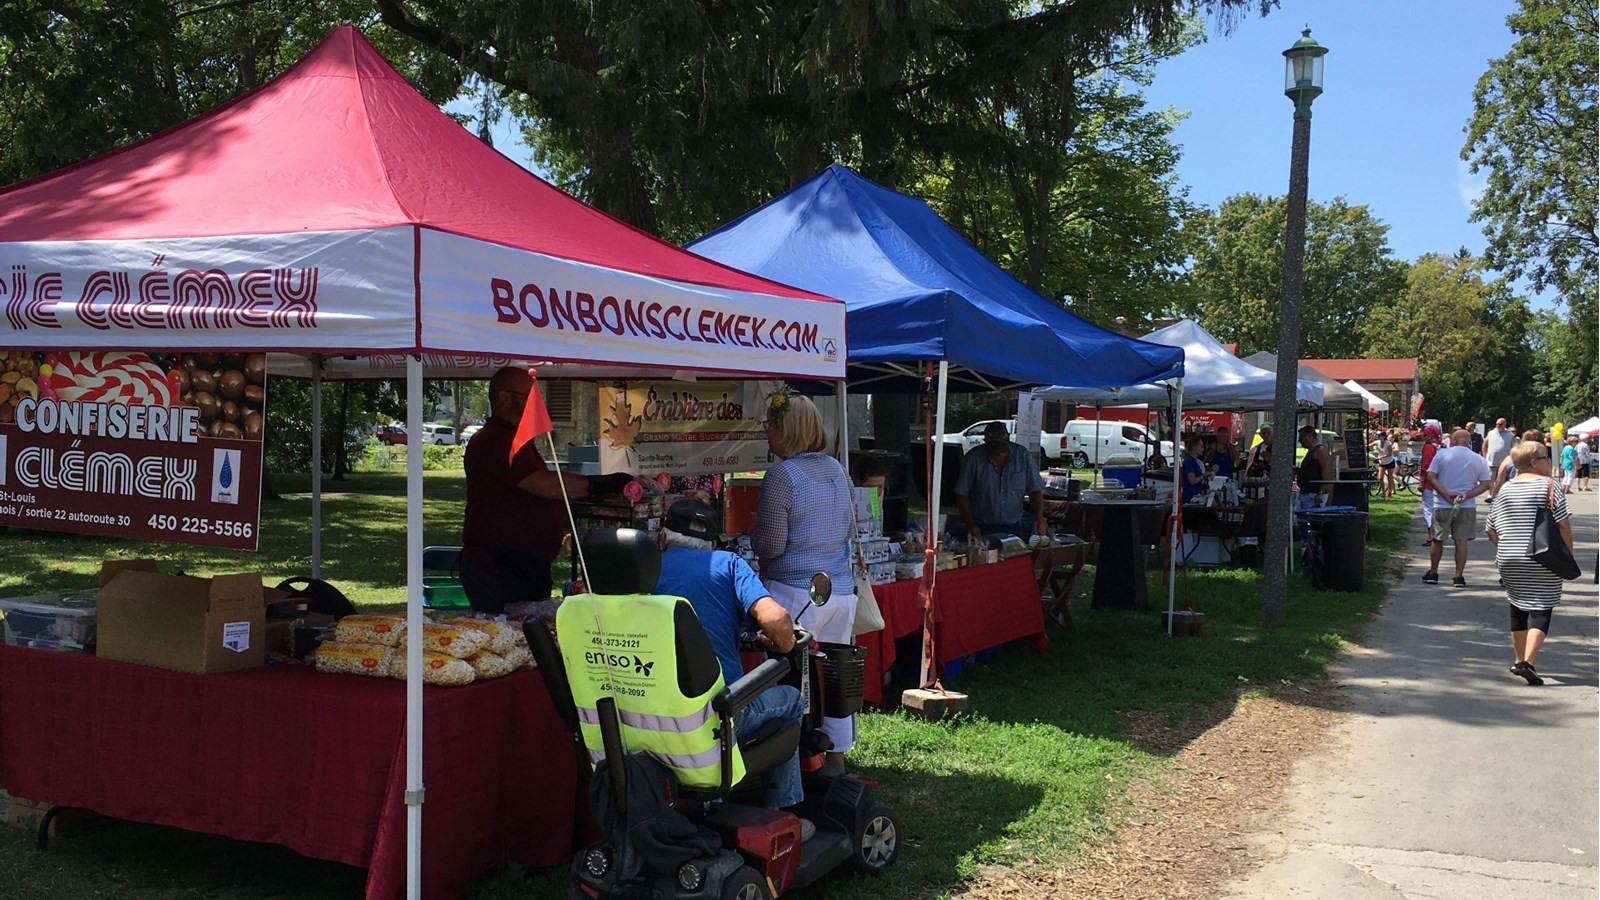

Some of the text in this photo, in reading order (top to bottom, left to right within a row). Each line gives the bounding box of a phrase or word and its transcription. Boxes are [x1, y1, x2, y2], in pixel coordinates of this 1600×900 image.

[16, 397, 200, 443] CONFISERIE
[643, 433, 669, 442] GRAND
[25, 507, 52, 519] sortie
[55, 510, 66, 520] 22
[69, 511, 115, 526] autoroute
[118, 516, 130, 526] 30
[147, 514, 252, 539] 450 225-5566
